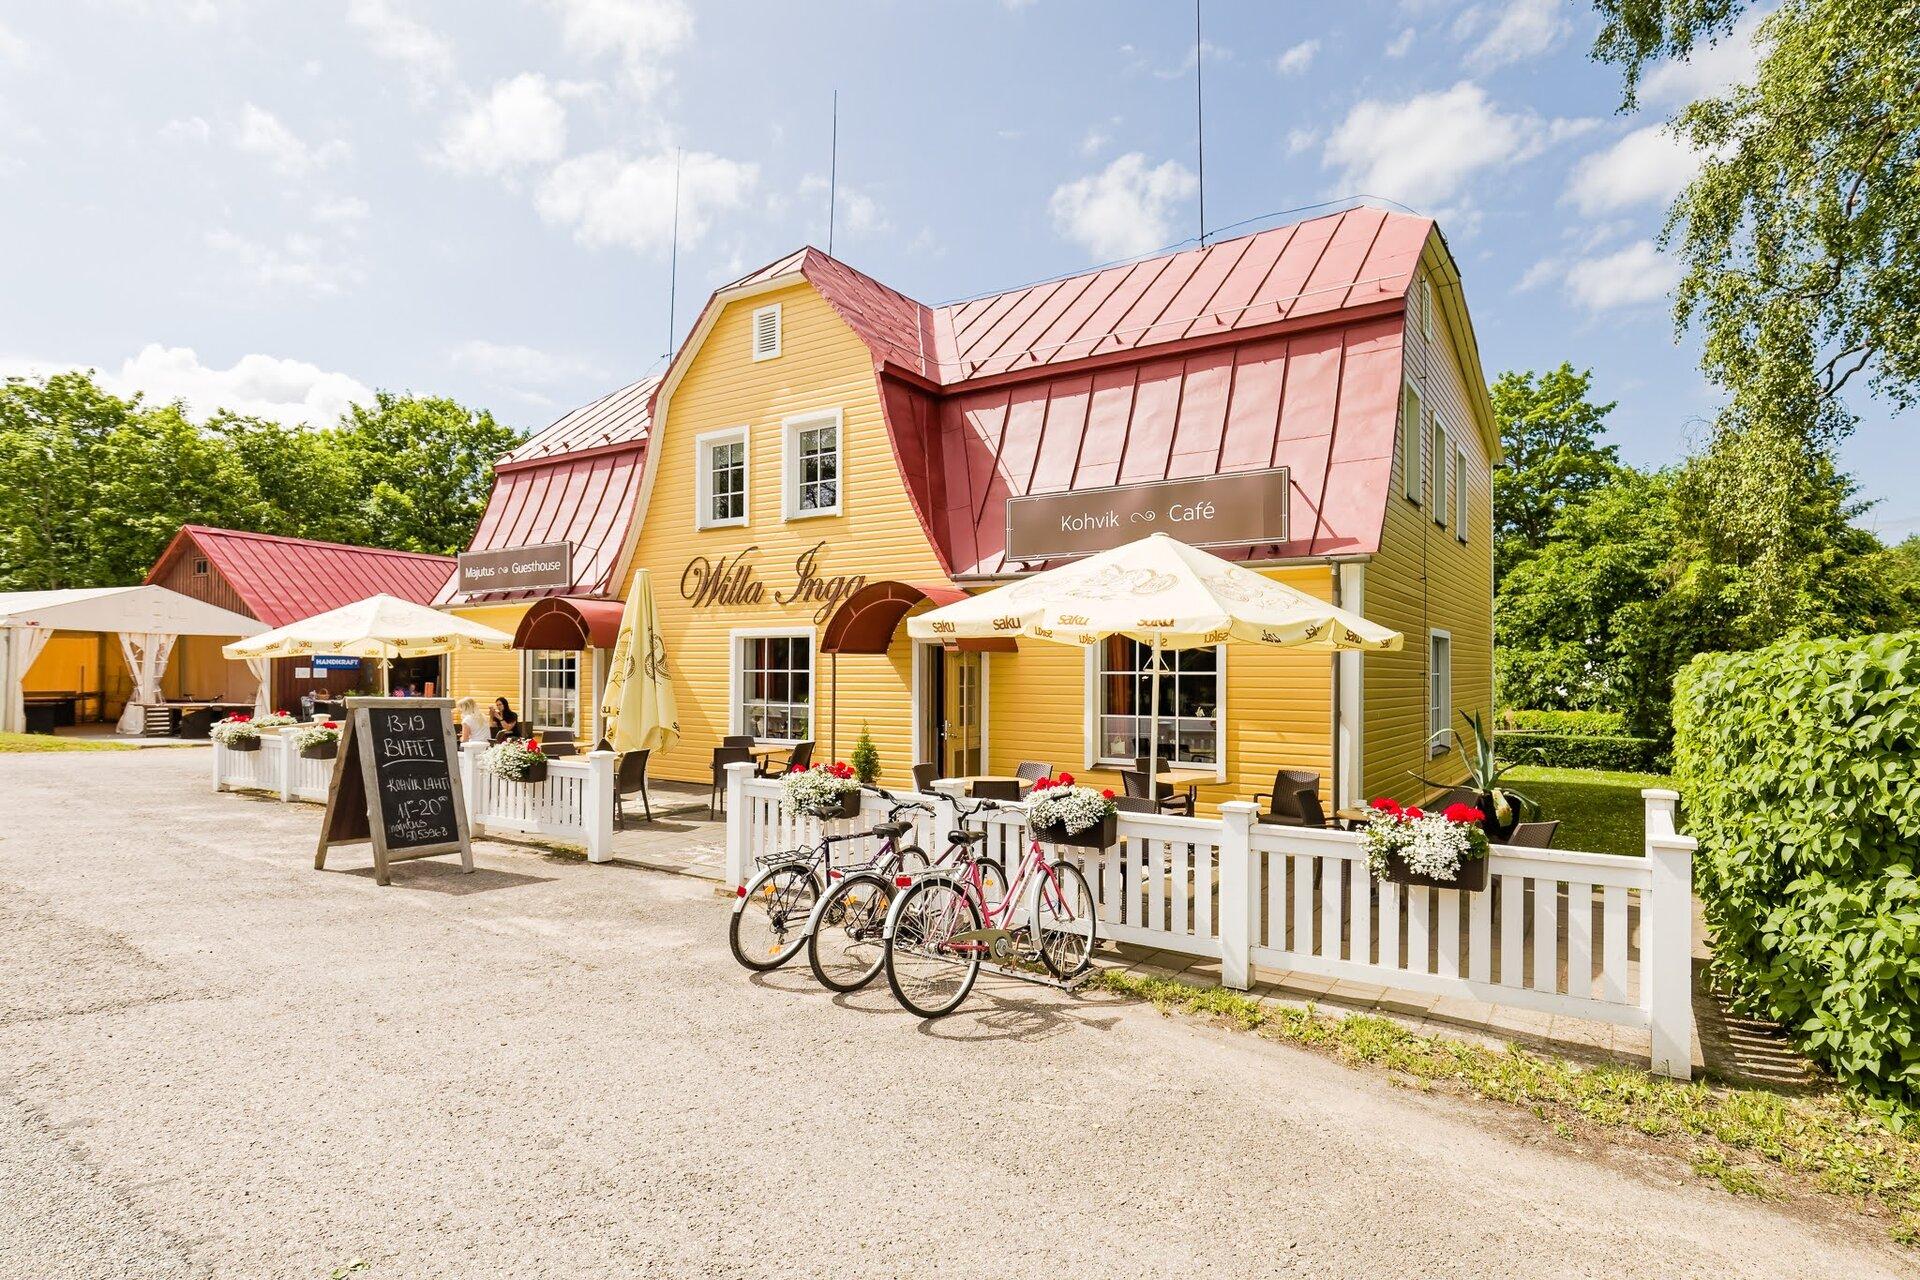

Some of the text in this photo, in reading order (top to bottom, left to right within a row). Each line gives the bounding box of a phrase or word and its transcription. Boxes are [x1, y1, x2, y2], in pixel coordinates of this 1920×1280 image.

[1061, 501, 1215, 531] Kohvik Café
[465, 560, 561, 580] Majutus Guesthouse
[680, 546, 765, 608] Willa
[932, 620, 956, 633] saku
[992, 615, 1022, 631] saku
[387, 714, 425, 732] 13-19
[384, 738, 434, 757] BUFFET
